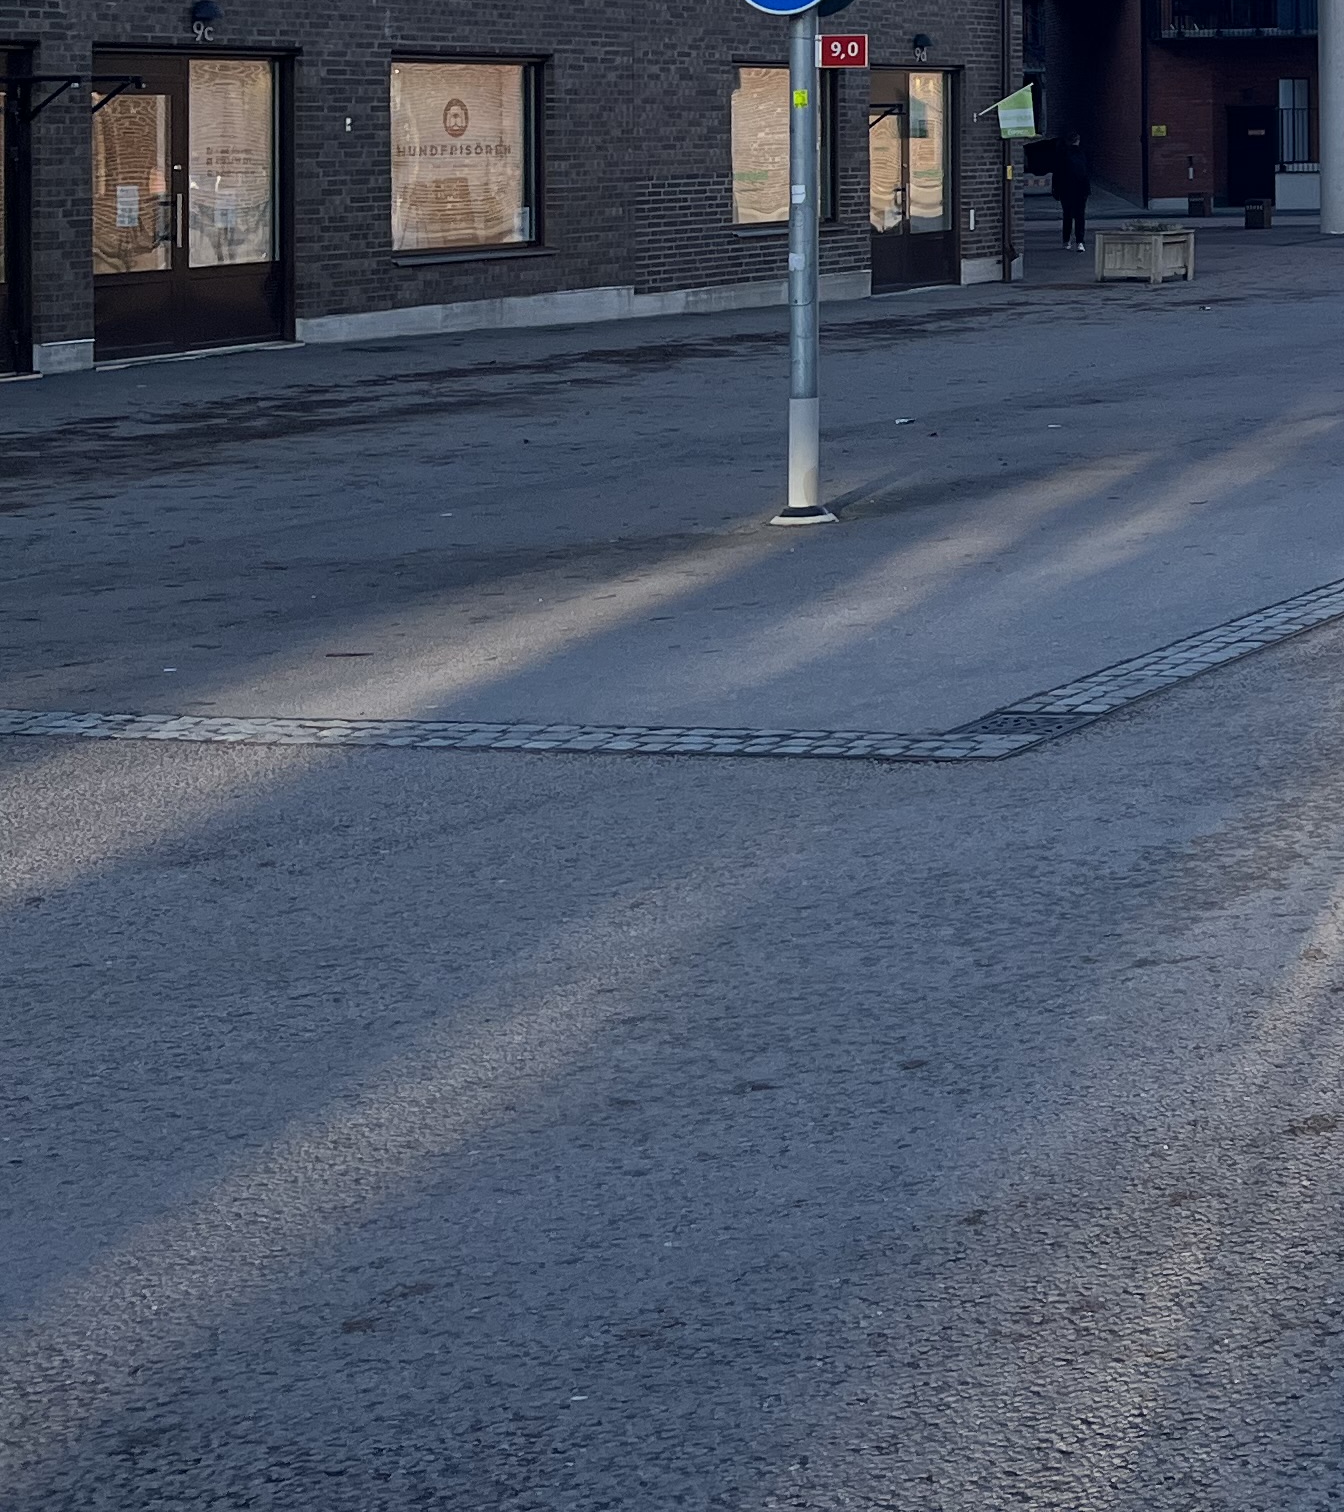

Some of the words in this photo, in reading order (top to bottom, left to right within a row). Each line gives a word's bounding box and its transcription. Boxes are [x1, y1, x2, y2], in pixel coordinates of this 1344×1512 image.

[830, 41, 859, 60] 9,0
[914, 47, 928, 62] 9d
[396, 143, 512, 157] HUNDFRISÖREN
